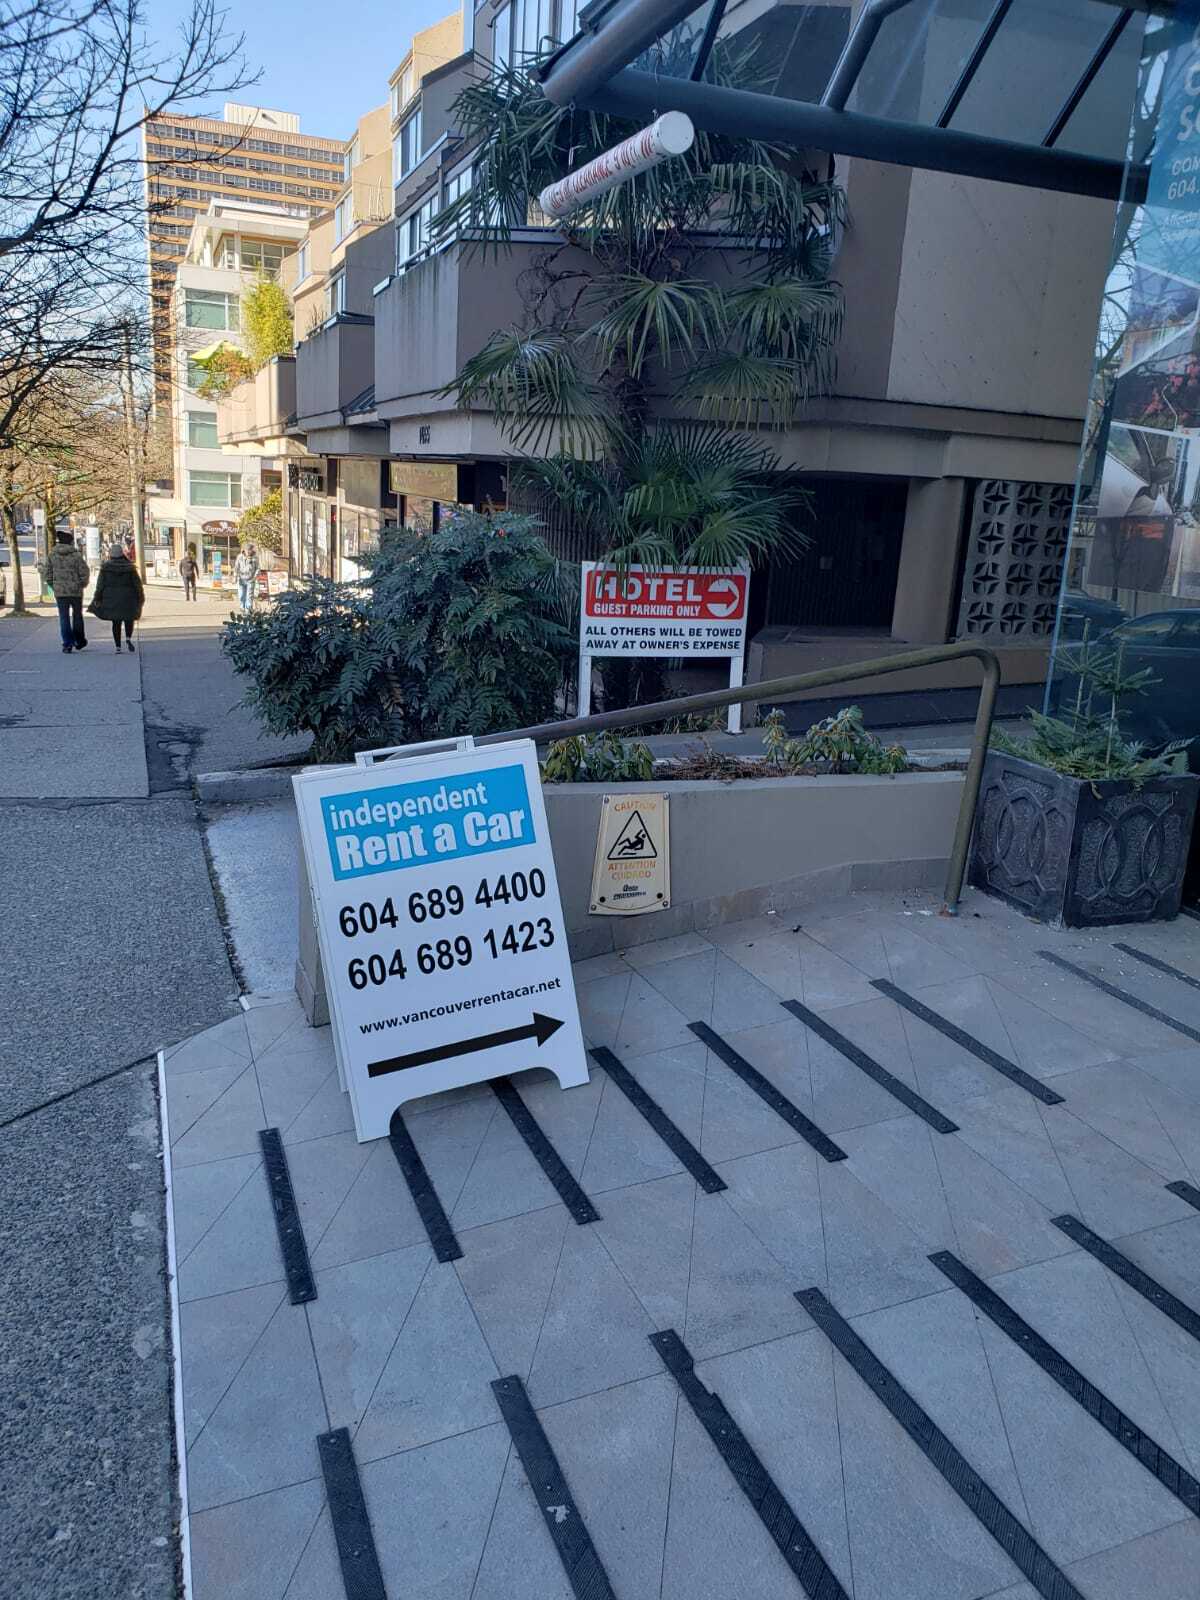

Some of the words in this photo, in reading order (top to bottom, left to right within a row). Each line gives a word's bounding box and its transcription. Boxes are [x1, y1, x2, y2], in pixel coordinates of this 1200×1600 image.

[595, 575, 703, 602] HOTEL
[593, 603, 628, 615] GUEST
[630, 604, 674, 616] PARKING
[676, 605, 701, 617] ONLY
[585, 626, 607, 636] ALL
[610, 626, 656, 636] OTHERS
[659, 627, 685, 637] WILL
[688, 627, 702, 637] BE
[705, 627, 742, 637] TOWED
[586, 639, 619, 649] AWAY
[621, 640, 636, 649] AT
[639, 640, 690, 650] OWNER'S
[692, 640, 741, 650] EXPENSE
[329, 782, 489, 831] independent
[335, 824, 428, 872] Rent
[432, 822, 457, 853] a
[463, 808, 525, 847] Car
[607, 860, 656, 872] ATTENTION
[339, 897, 399, 938] 604
[408, 885, 464, 923] 689
[475, 868, 546, 909] 4400
[348, 949, 407, 990] 604
[417, 935, 473, 975] 689
[483, 917, 555, 960] 1423
[359, 977, 562, 1035] www.vancouverrentacar.net
